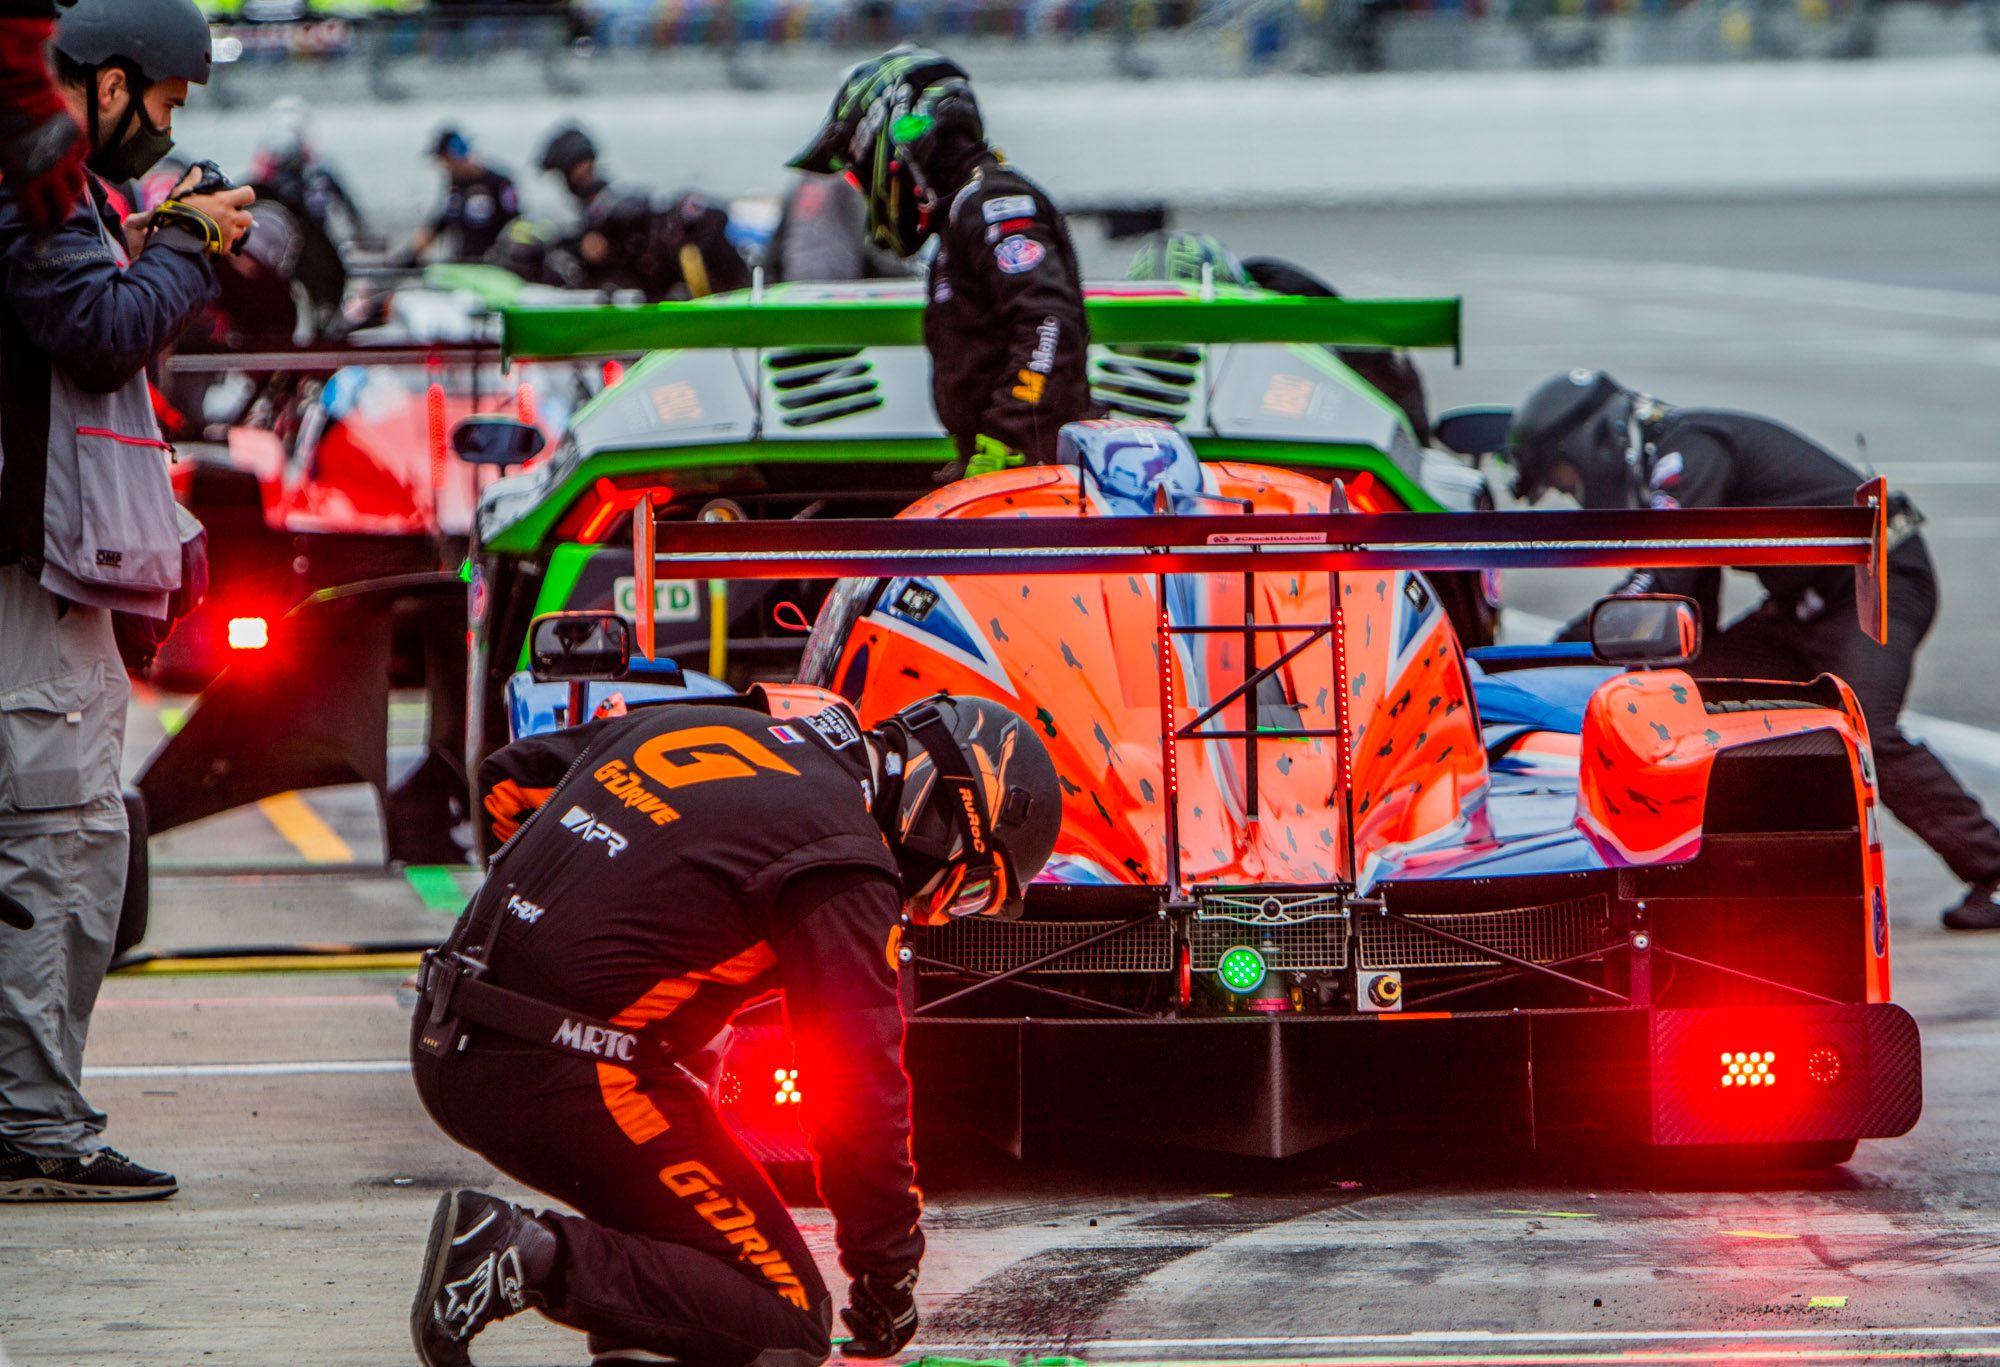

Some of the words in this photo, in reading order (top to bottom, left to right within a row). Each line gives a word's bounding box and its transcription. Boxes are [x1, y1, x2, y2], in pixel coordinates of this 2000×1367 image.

[594, 759, 681, 826] G-DRIVE
[571, 812, 629, 858] APR
[551, 1018, 638, 1061] MRTC
